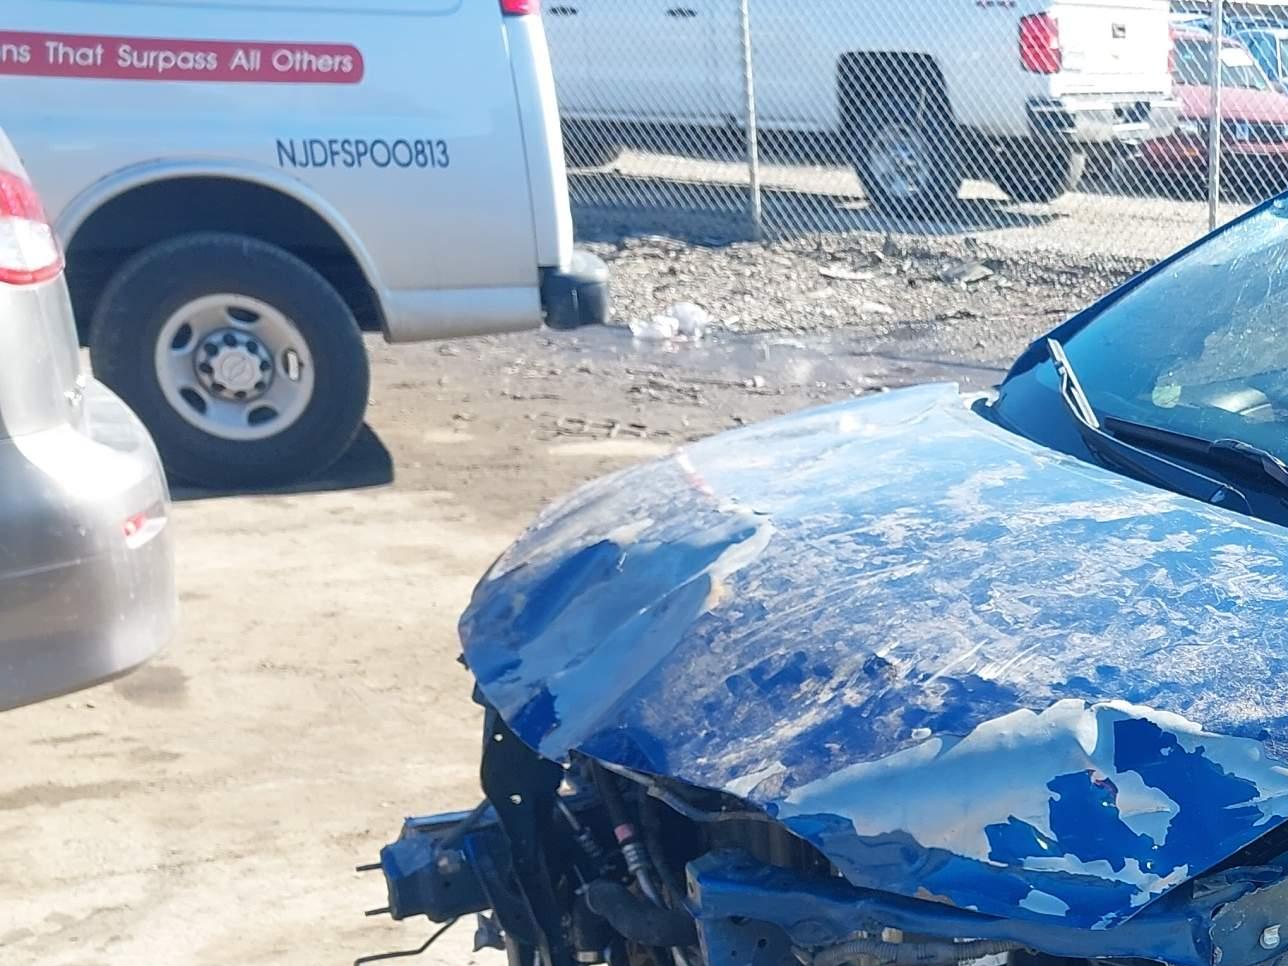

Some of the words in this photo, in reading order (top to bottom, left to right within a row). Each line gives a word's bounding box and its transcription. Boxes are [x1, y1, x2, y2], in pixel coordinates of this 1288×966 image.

[46, 41, 104, 66] That
[117, 44, 218, 73] Surpass
[230, 49, 260, 71] All
[271, 49, 353, 73] Others
